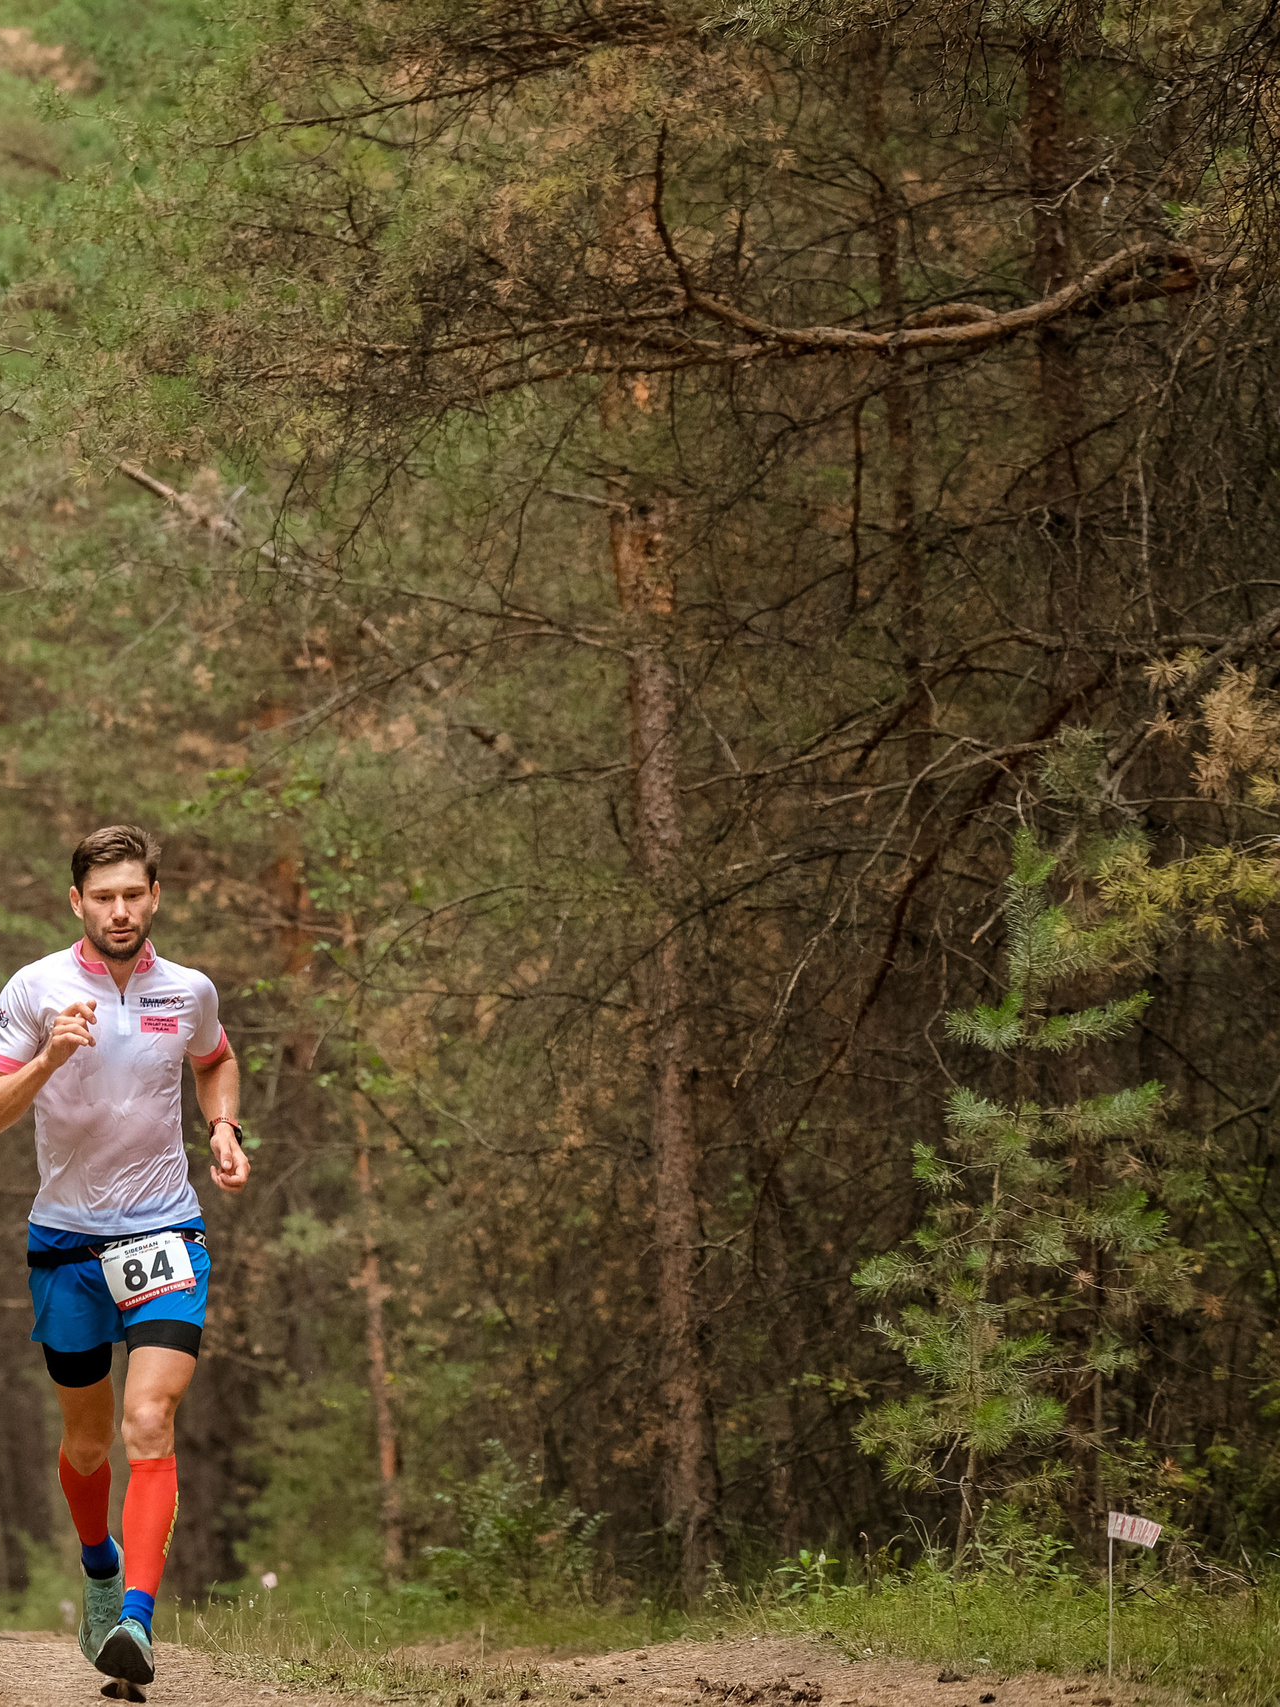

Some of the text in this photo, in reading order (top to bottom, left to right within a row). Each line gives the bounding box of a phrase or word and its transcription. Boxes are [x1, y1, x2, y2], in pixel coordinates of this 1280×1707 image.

[124, 1241, 159, 1256] SIBERMAN
[122, 1249, 175, 1292] 84
[160, 1281, 186, 1294] ЕВГЕНИЙ
